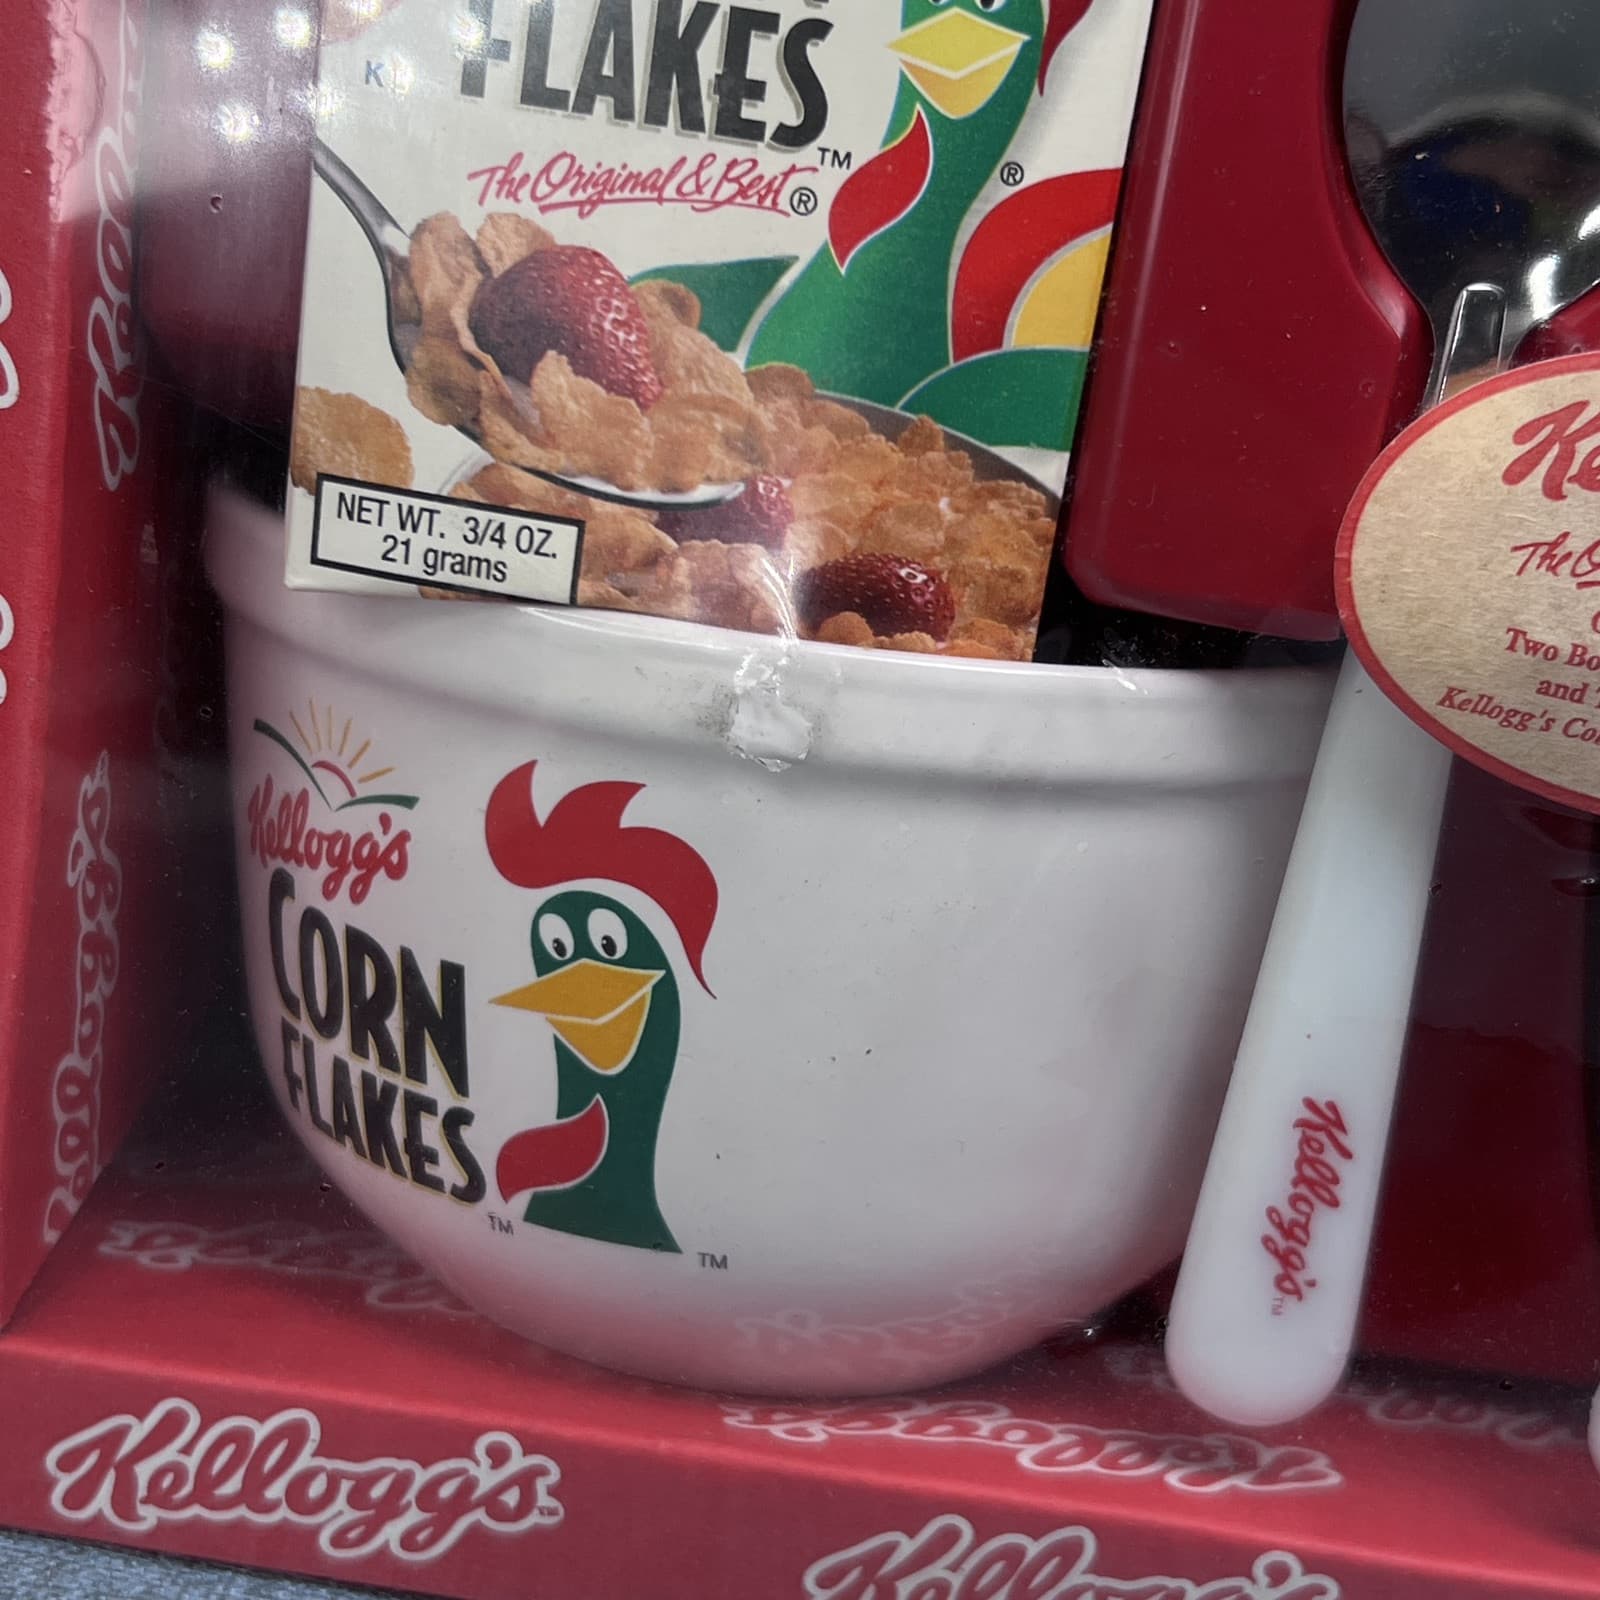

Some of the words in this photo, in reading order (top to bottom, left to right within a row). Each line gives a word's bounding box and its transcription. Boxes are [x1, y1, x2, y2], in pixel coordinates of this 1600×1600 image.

[459, 0, 834, 151] FLAKES
[467, 151, 532, 206] The
[530, 150, 688, 219] Original
[675, 152, 717, 199] &
[336, 491, 391, 528] NET
[397, 503, 446, 539] WT.
[462, 516, 507, 550] 3/4
[514, 525, 558, 560] OZ.
[380, 534, 412, 565] 21
[422, 546, 508, 583] grams
[1510, 531, 1574, 577] The
[1504, 627, 1560, 662] Two
[1437, 686, 1557, 733] Kellogg's
[1535, 679, 1591, 705] and
[247, 773, 412, 905] Kellogg's
[267, 866, 470, 1099] CORN
[280, 1020, 487, 1207] FLAKES
[1260, 1096, 1354, 1302] Kellogg's
[697, 1251, 729, 1271] TM
[46, 1397, 562, 1561] Kellogg's
